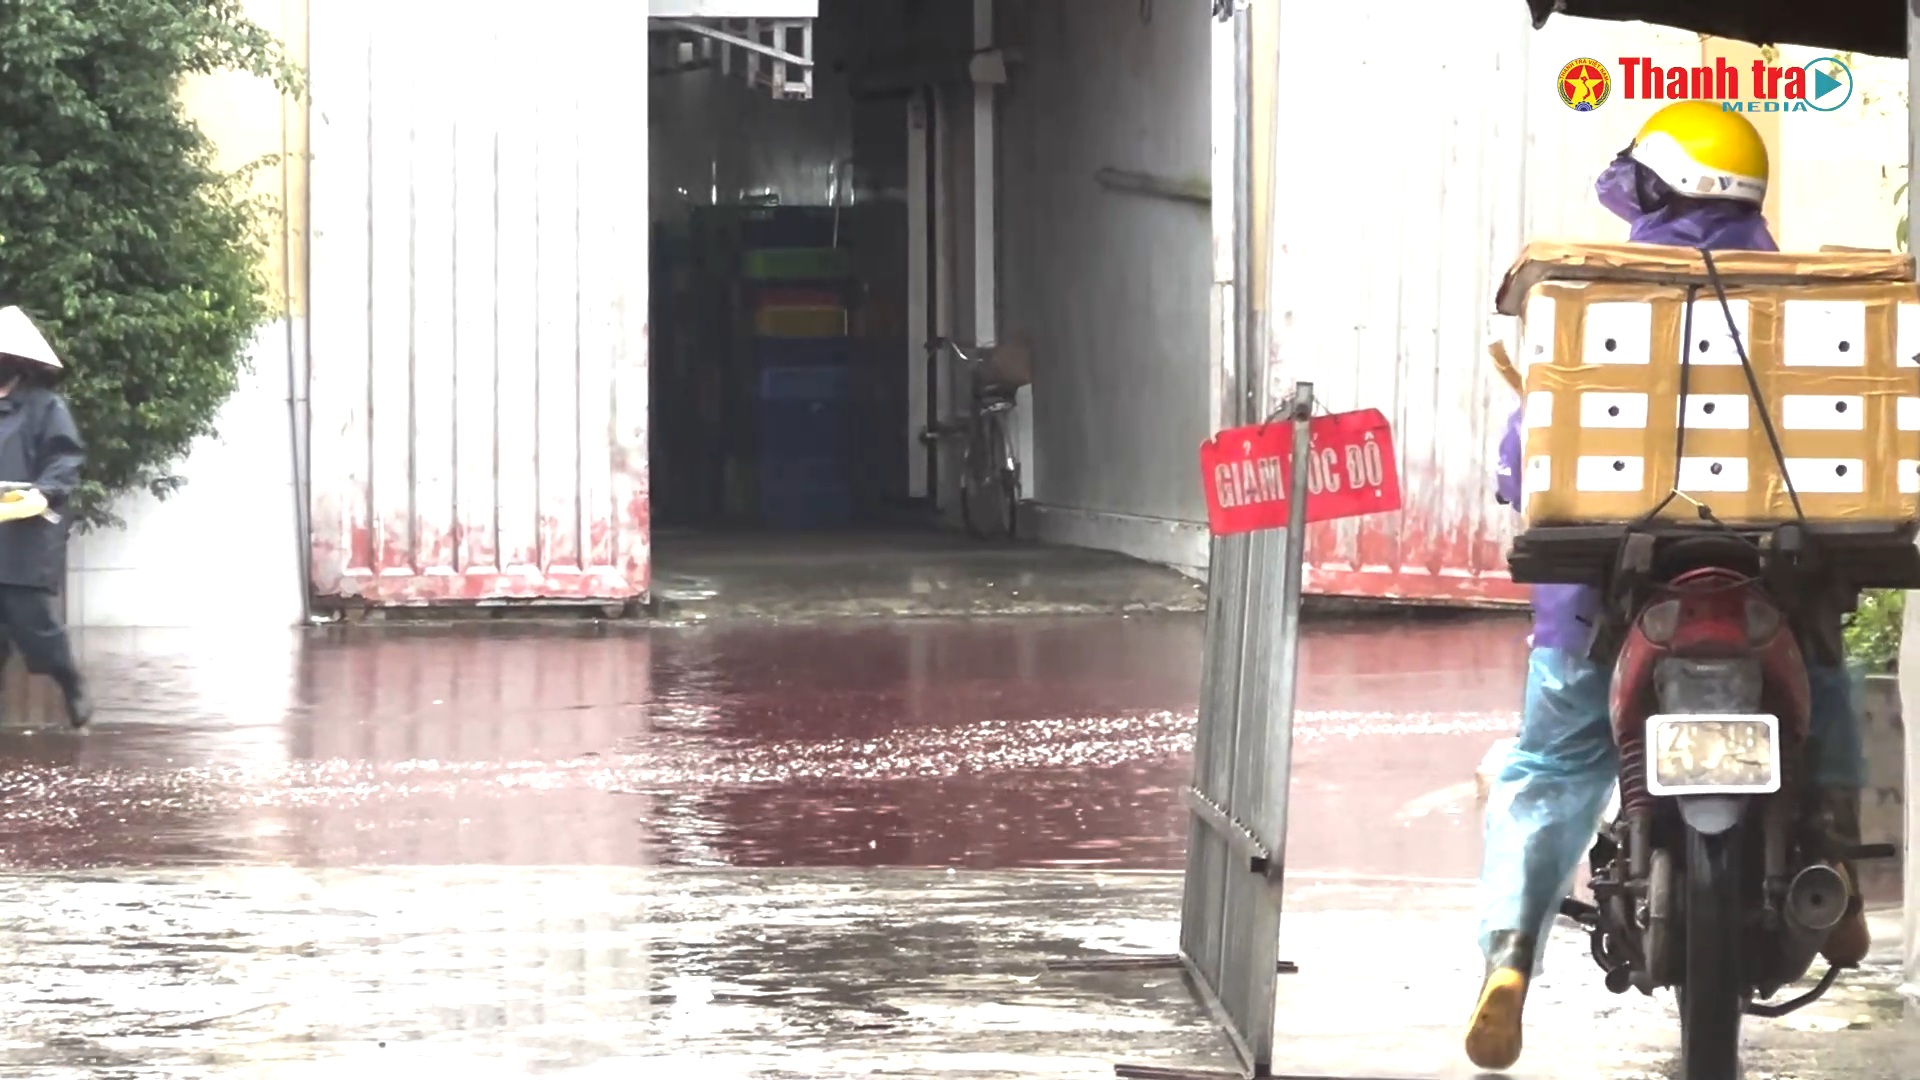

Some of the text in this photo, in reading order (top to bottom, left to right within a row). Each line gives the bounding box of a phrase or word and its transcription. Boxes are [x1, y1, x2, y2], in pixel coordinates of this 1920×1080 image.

[1215, 432, 1382, 508] GIẢM ỐC ĐỘ
